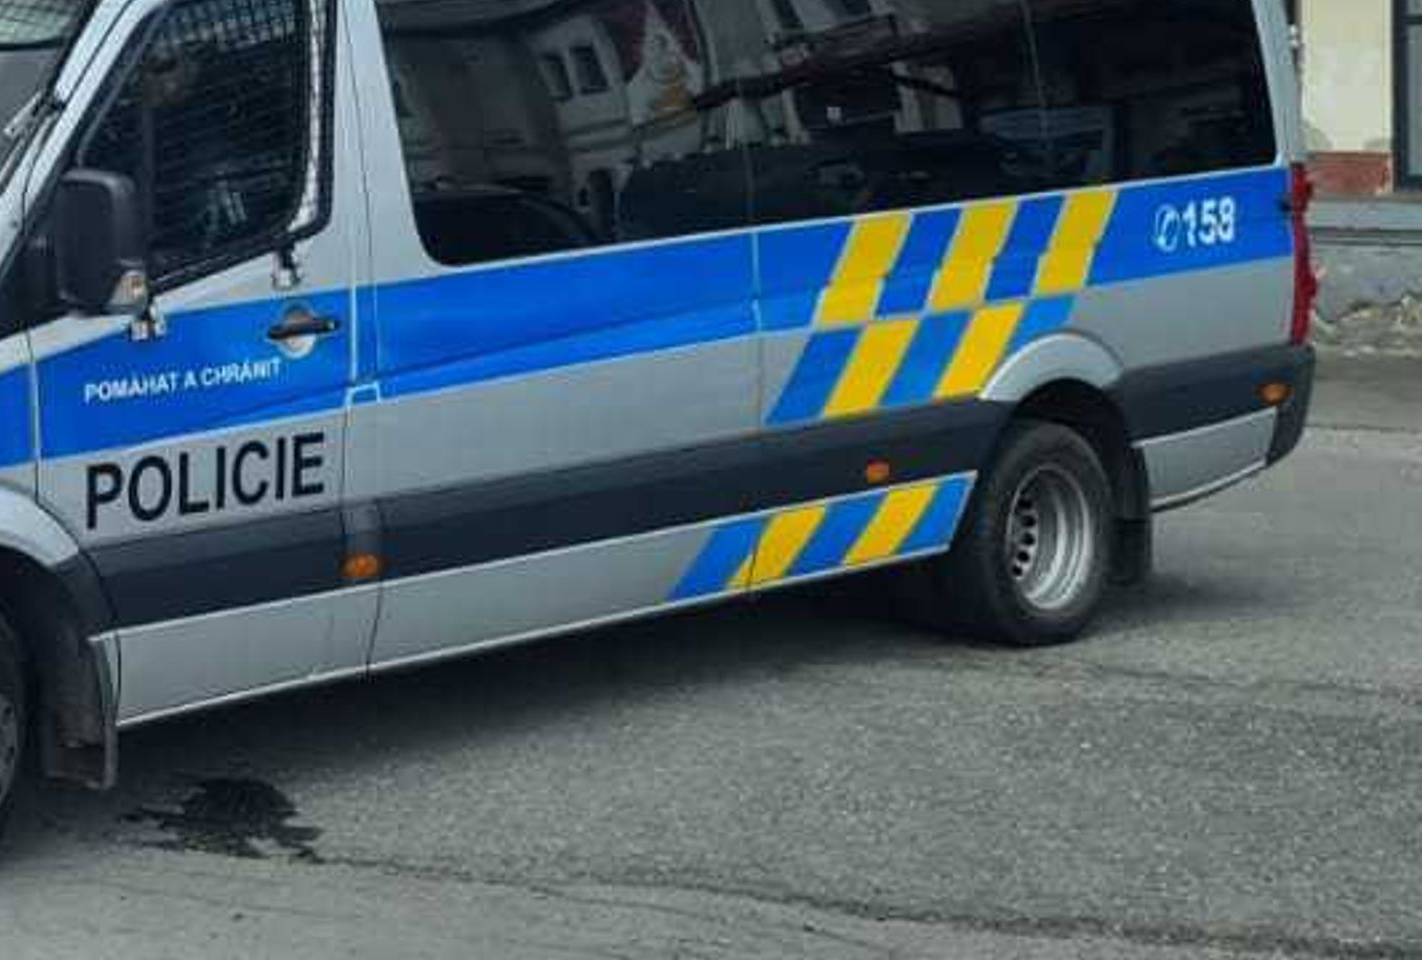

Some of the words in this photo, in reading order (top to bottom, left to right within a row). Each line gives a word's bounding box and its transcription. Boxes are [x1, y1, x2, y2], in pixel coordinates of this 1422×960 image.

[1182, 196, 1235, 247] 158
[184, 371, 199, 389] A
[85, 431, 325, 530] POLICIE
